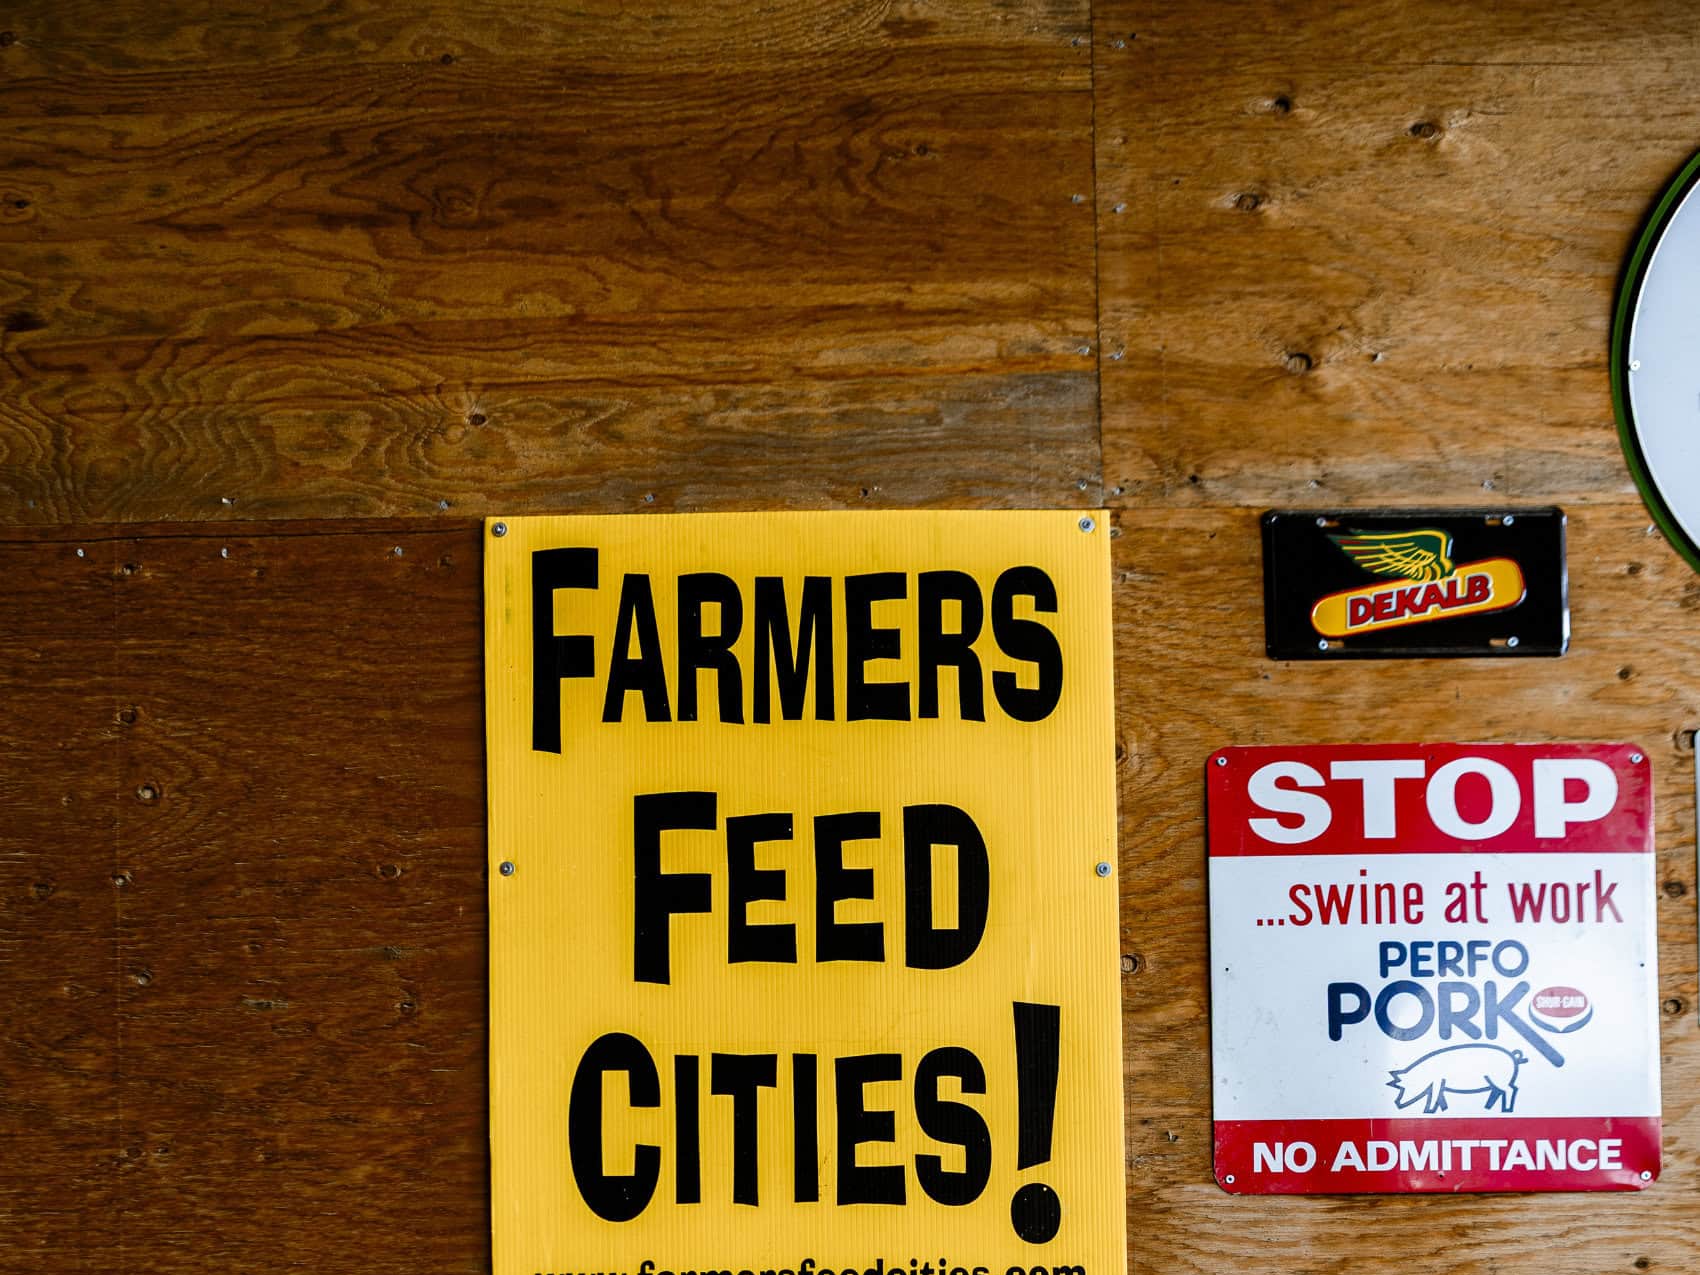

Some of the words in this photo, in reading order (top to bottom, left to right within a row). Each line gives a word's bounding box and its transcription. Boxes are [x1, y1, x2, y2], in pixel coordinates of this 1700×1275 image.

[1347, 574, 1493, 629] DEKALB
[532, 546, 1063, 754] FARMERS
[1247, 757, 1618, 844] STOP
[634, 791, 990, 985] FEED
[1256, 869, 1424, 927] ...swine
[1444, 871, 1487, 924] at
[1508, 869, 1623, 924] work
[1379, 939, 1530, 979] PERFO
[1327, 980, 1565, 1068] PORK
[568, 1001, 1061, 1244] CITIES!
[1253, 1141, 1316, 1173] NO
[1330, 1138, 1623, 1172] ADMITTANCE
